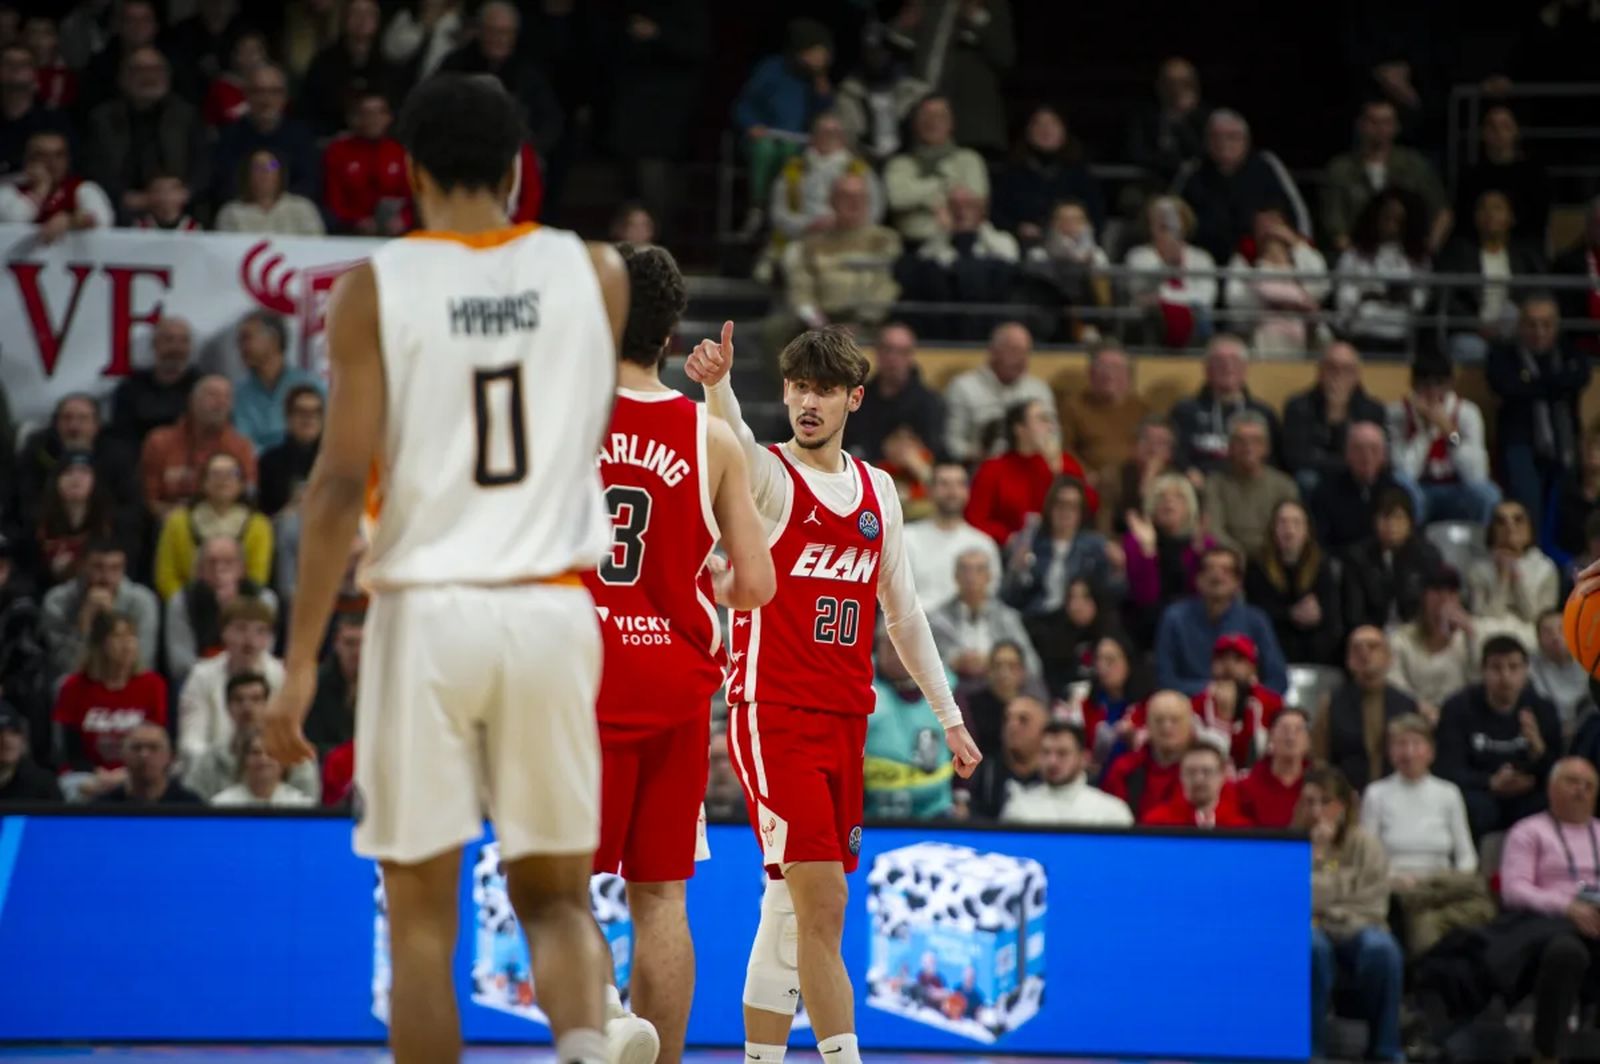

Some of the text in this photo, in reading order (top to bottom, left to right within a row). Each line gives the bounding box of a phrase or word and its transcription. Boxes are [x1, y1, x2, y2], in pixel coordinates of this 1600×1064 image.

[472, 361, 529, 487] 0
[790, 542, 879, 584] ELAN
[614, 616, 672, 632] VICKY
[622, 634, 672, 646] FOODS
[814, 596, 860, 647] 20
